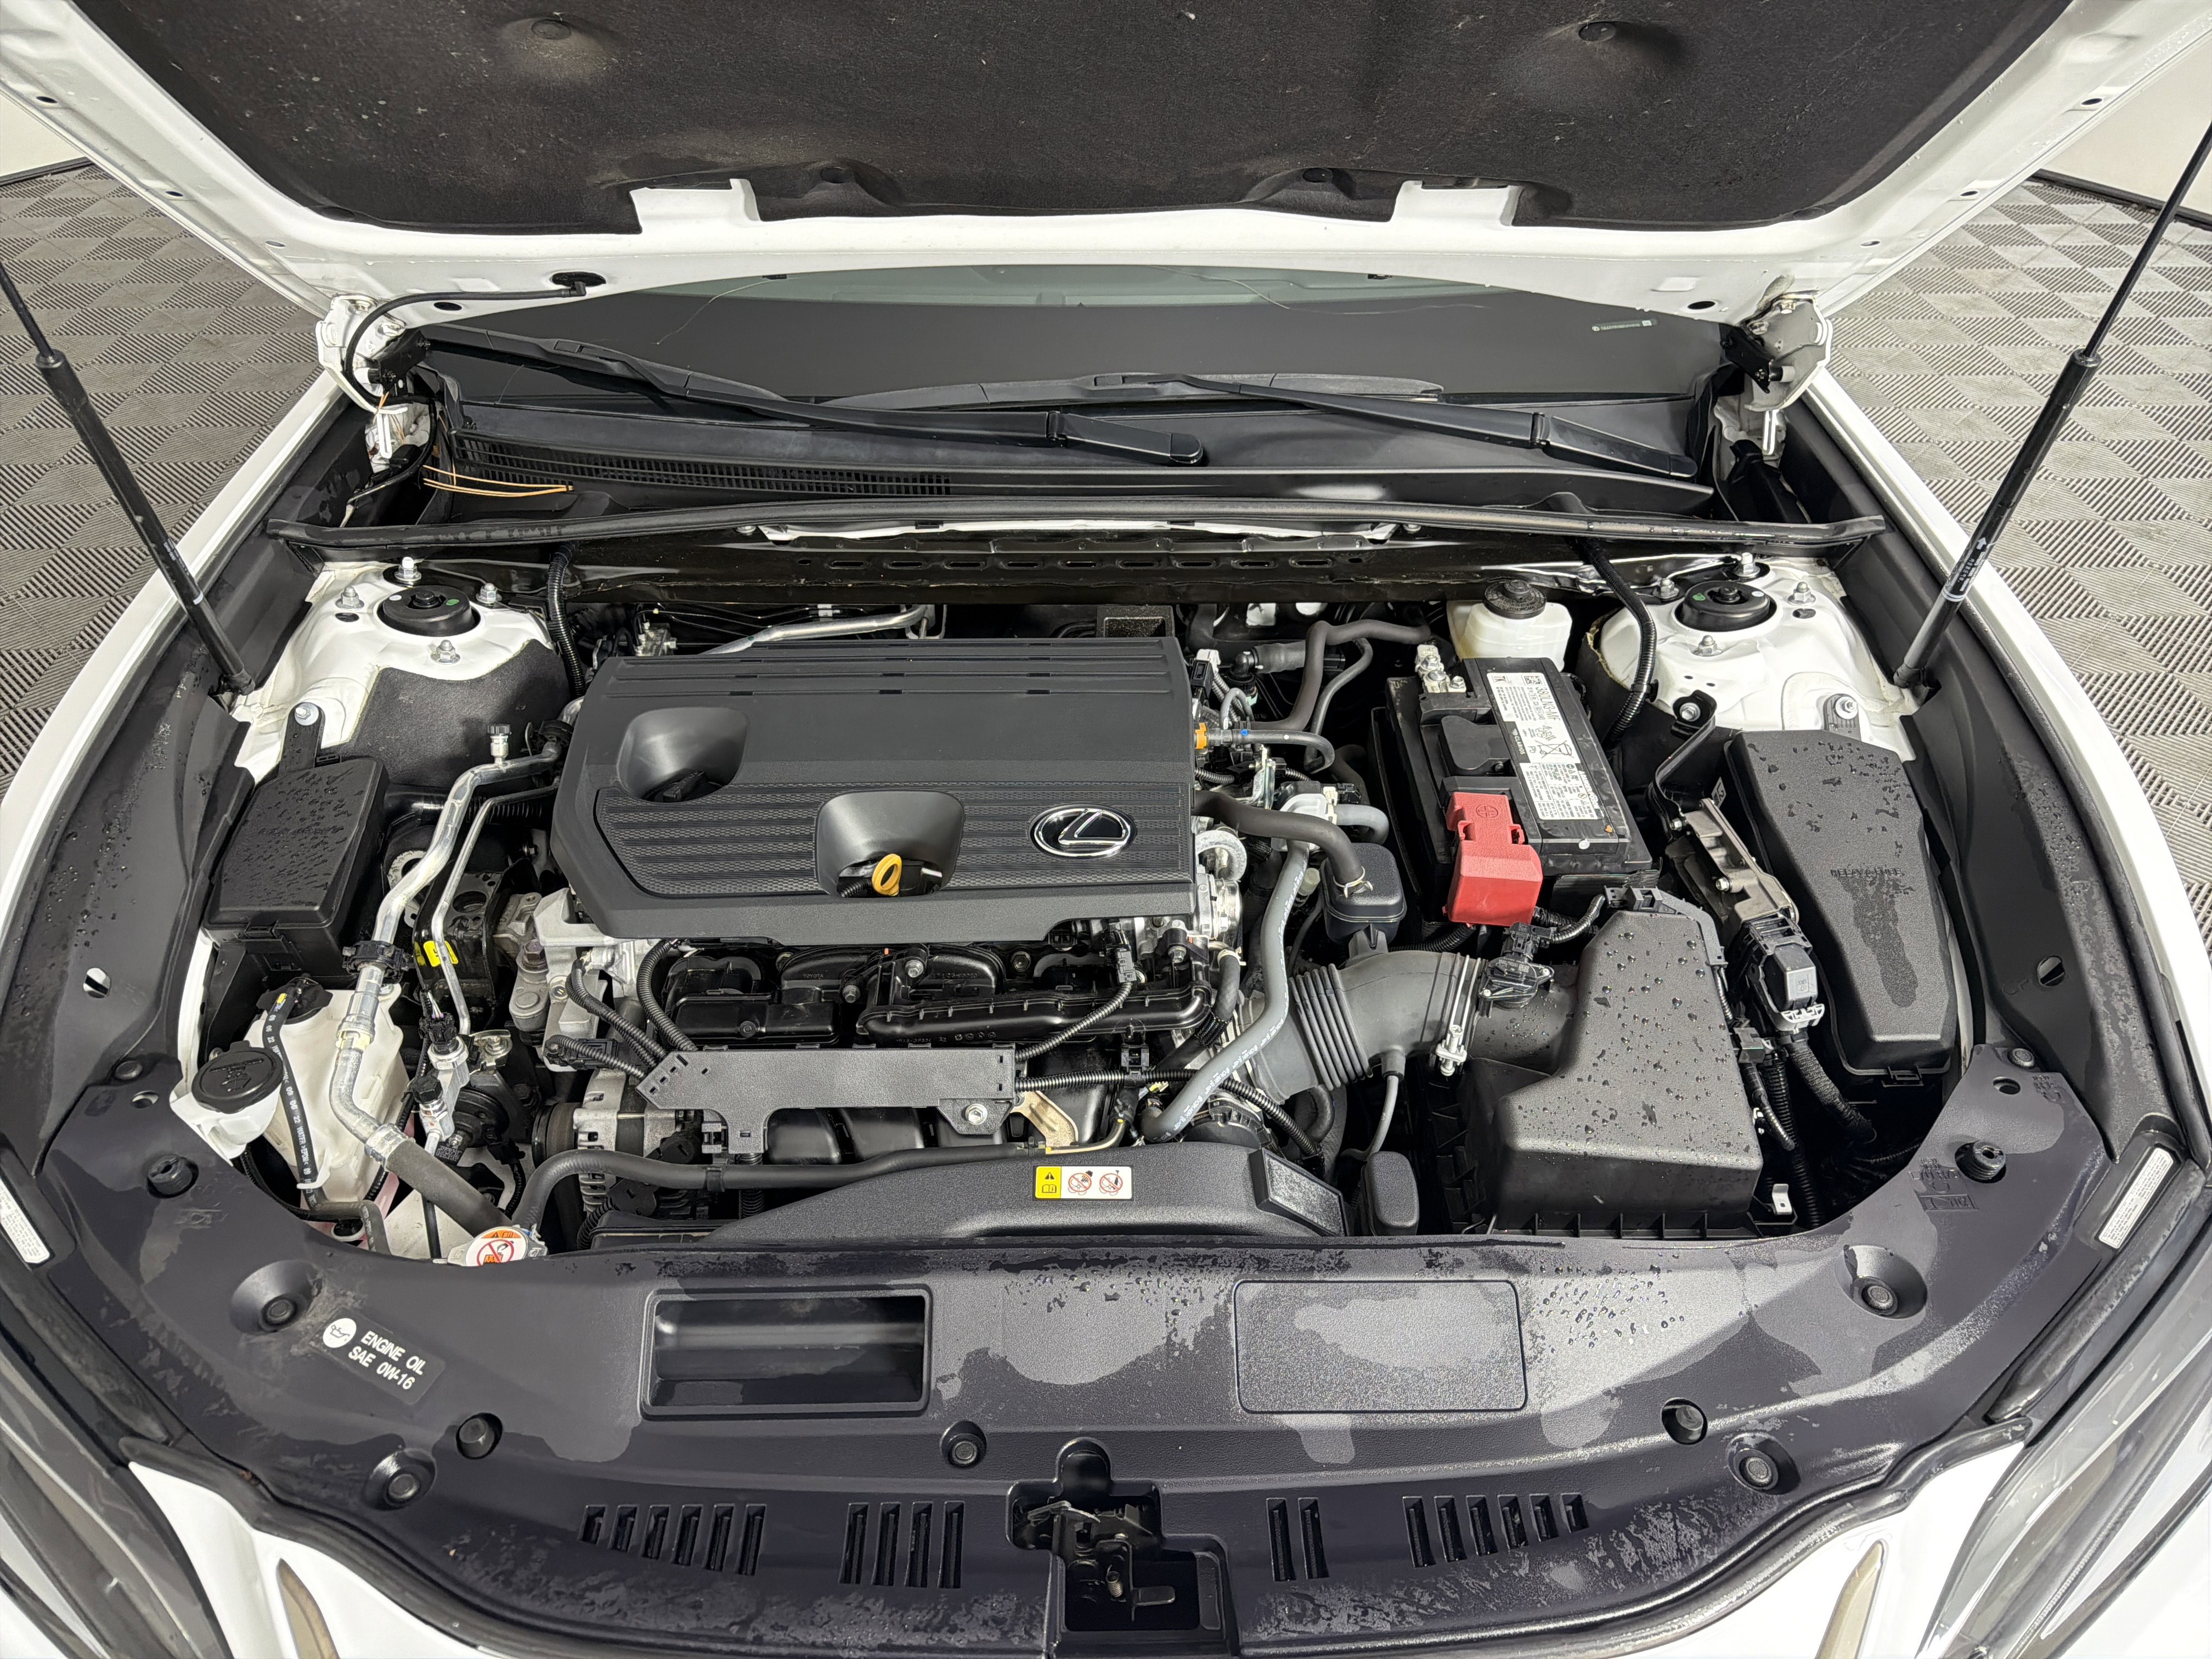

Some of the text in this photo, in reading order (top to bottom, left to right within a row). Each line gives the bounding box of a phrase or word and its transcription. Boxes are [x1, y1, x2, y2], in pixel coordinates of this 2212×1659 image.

[1535, 687, 1561, 721] 380LN3-MF
[1514, 735, 1526, 755] CLARIOS
[293, 1115, 301, 1124] 22
[296, 1126, 307, 1145] WATER
[361, 1330, 427, 1375] ENGINE OIL
[348, 1346, 415, 1390] SAE 0W-16
